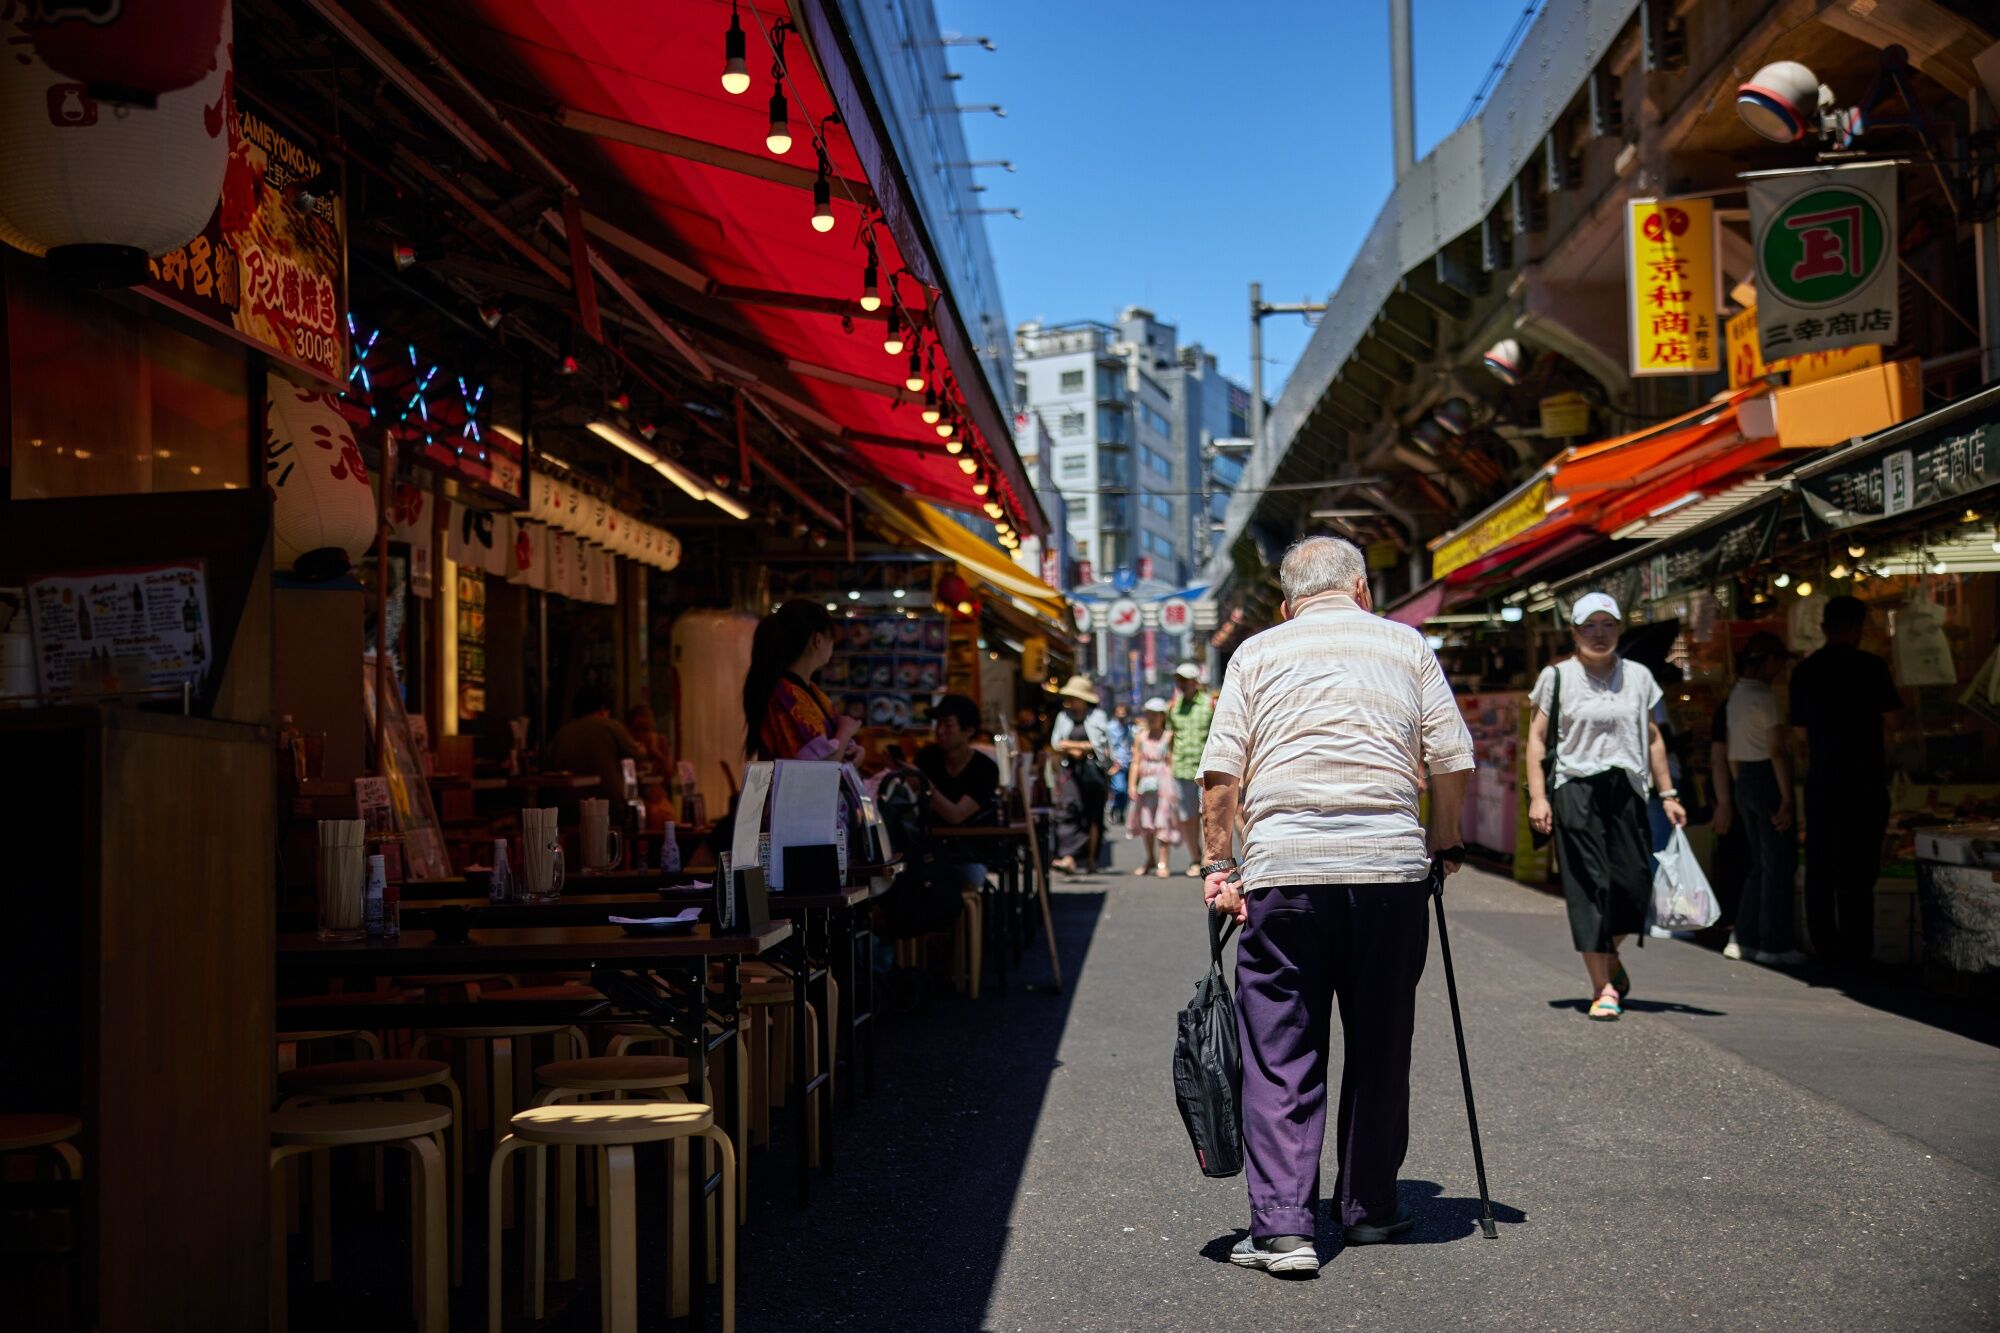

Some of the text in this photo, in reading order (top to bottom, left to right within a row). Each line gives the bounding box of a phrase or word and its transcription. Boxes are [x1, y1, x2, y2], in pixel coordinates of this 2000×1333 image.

[244, 248, 336, 332] アメ横焼き
[1647, 256, 1692, 365] 京和商店
[296, 327, 334, 368] 300円
[1764, 308, 1893, 348] 三幸商店
[1917, 428, 1986, 491] 三幸商店
